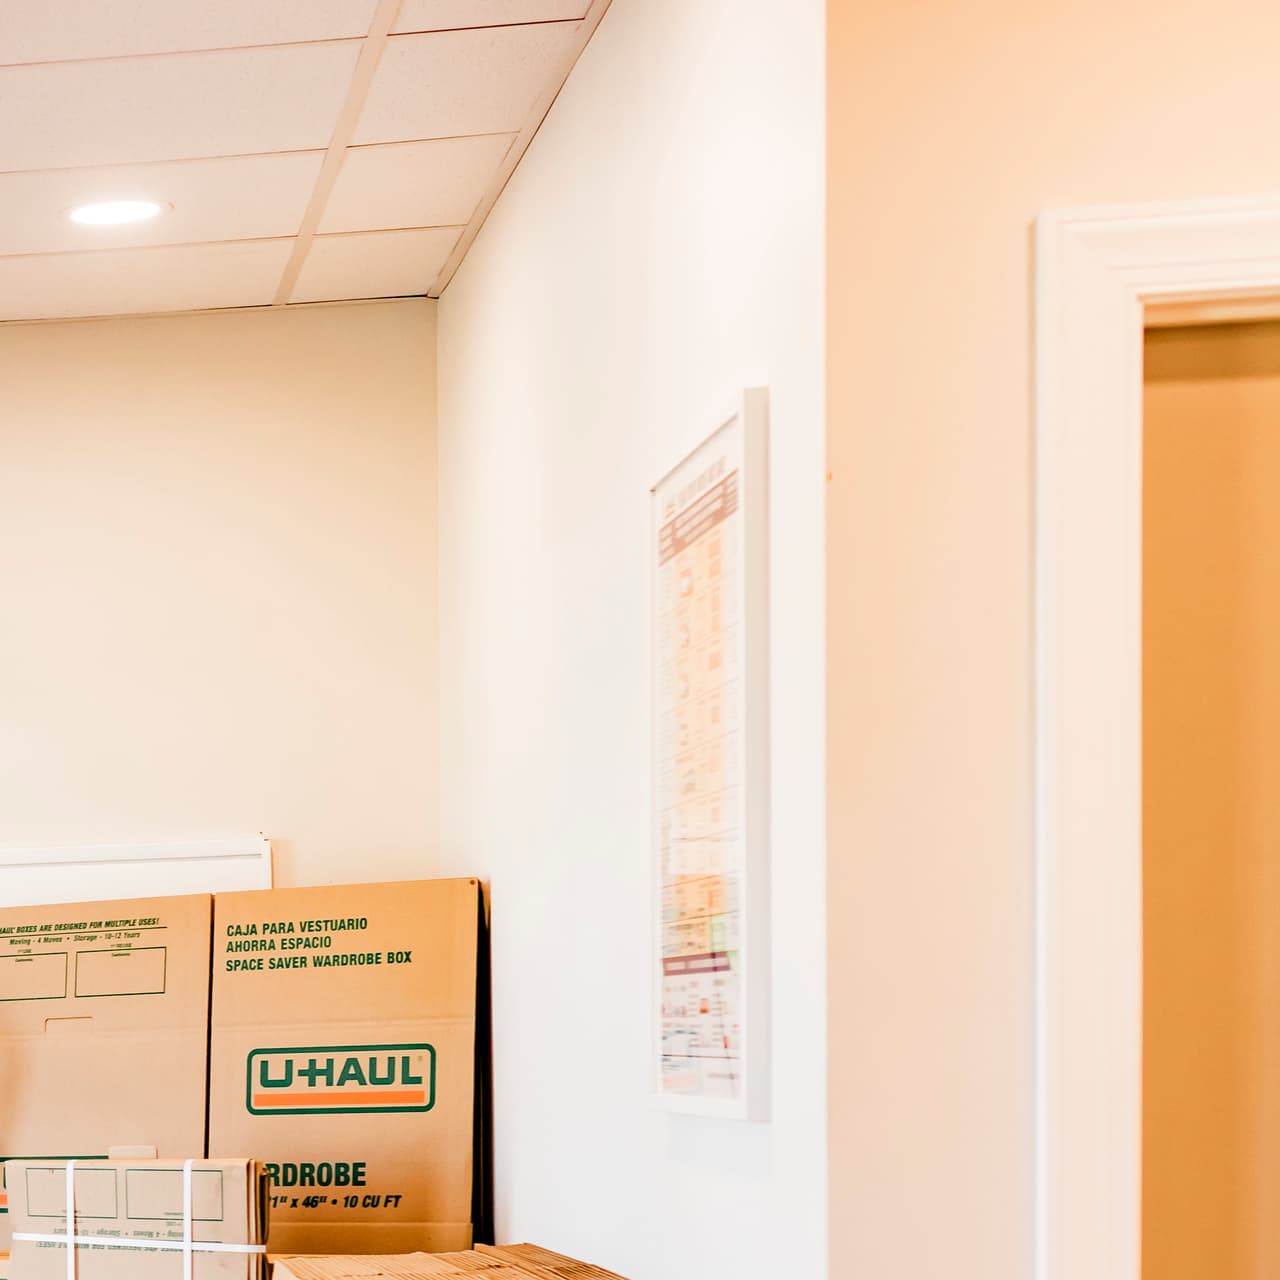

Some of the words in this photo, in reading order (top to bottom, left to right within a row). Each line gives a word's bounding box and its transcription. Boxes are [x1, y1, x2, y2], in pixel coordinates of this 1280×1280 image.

[16, 926, 37, 934] BOXES
[39, 924, 52, 932] ARE
[54, 922, 87, 931] DESIGNED
[89, 921, 103, 929] FOR
[104, 920, 136, 928] MULTIPLE
[138, 917, 160, 926] USES!
[227, 924, 258, 937] CAJA
[262, 922, 295, 935] PARA
[299, 918, 368, 933] VESTUARIO
[10, 938, 30, 946] Moving
[73, 934, 97, 942] Storage
[226, 939, 276, 952] AHORRA
[280, 936, 332, 950] ESPACIO
[226, 958, 264, 971] SPACE
[268, 956, 308, 970] SAVER
[312, 952, 382, 967] WARDROBE
[386, 951, 413, 964] BOX
[260, 1056, 423, 1088] U-HAUL
[290, 1198, 299, 1208] x
[302, 1195, 328, 1208] 46"
[343, 1195, 358, 1208] 10
[362, 1195, 380, 1208] CU
[383, 1195, 402, 1208] FT
